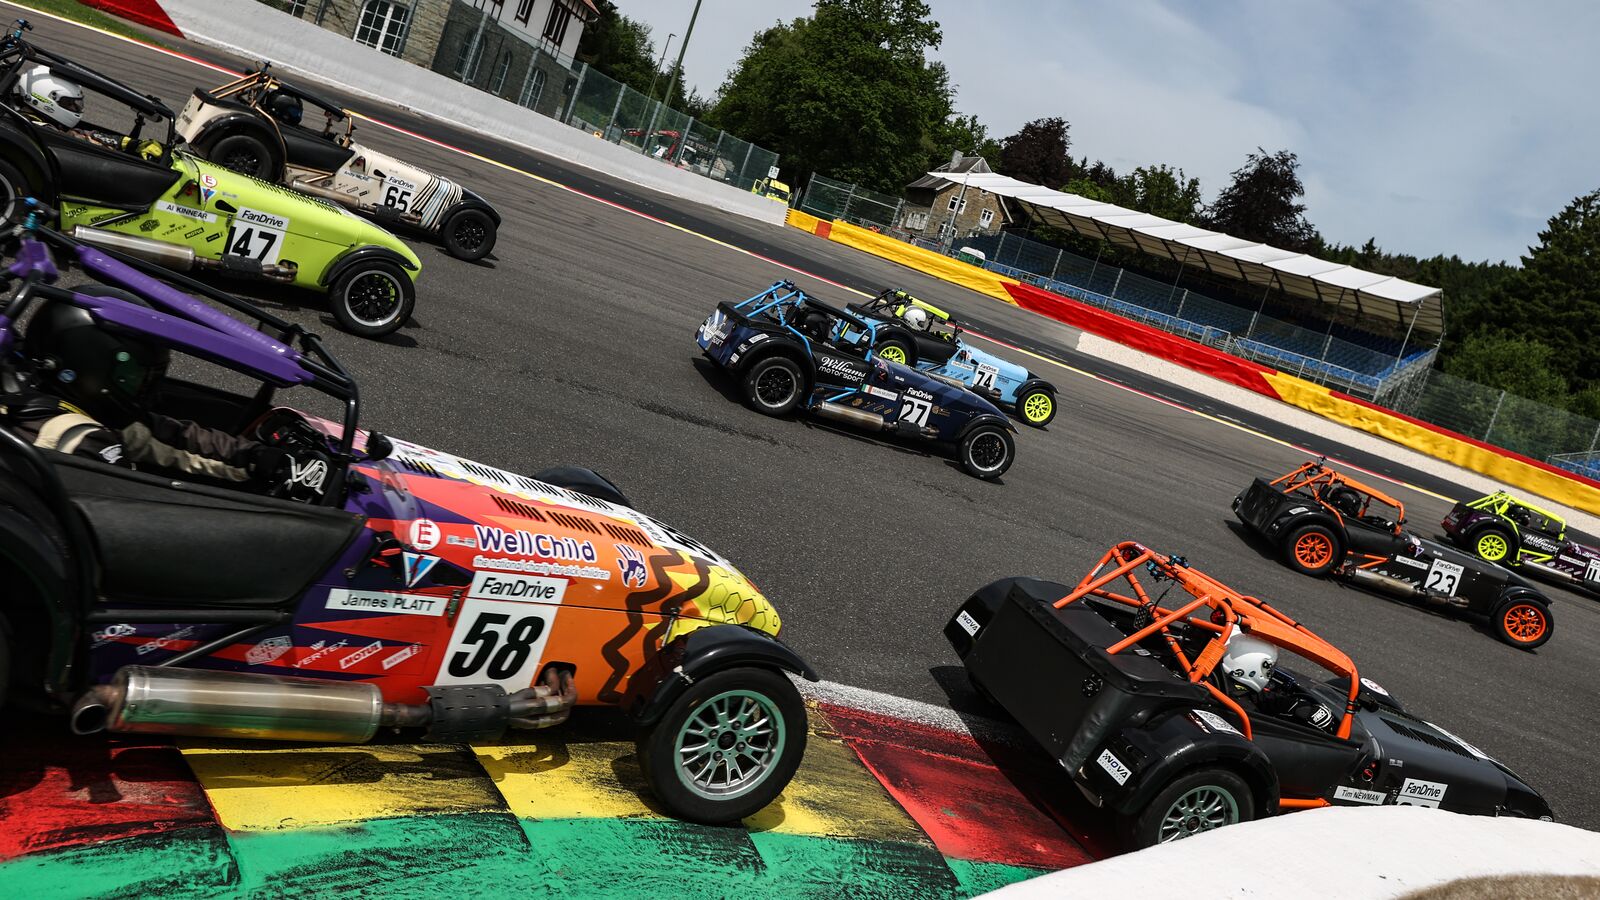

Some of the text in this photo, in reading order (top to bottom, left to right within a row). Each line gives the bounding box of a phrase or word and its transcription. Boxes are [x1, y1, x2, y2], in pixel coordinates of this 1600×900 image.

[389, 176, 415, 190] FanDrive
[384, 186, 411, 213] 65
[176, 206, 208, 219] KINNEAR
[242, 210, 284, 228] FanDrive
[162, 224, 187, 236] VERTEX
[186, 228, 204, 238] MOTUL
[223, 225, 277, 261] 147
[821, 356, 867, 377] Williams
[976, 370, 993, 387] 74
[907, 387, 934, 400] FanDrive
[898, 400, 928, 427] 27
[417, 524, 432, 545] E
[476, 526, 596, 562] WellChild
[475, 556, 611, 580] the national charity for sick children
[1436, 560, 1462, 573] FanDrive
[479, 577, 556, 600] FanDrive
[1427, 570, 1456, 595] 23
[341, 594, 436, 612] James PLATT
[961, 614, 979, 632] NOVA
[292, 639, 349, 669] VERTEX
[341, 641, 382, 668] MOTUL
[448, 612, 545, 680] 58
[1102, 753, 1128, 779] NOVA
[1342, 789, 1381, 802] Tim NEWMAN
[1405, 782, 1441, 798] FanDrive
